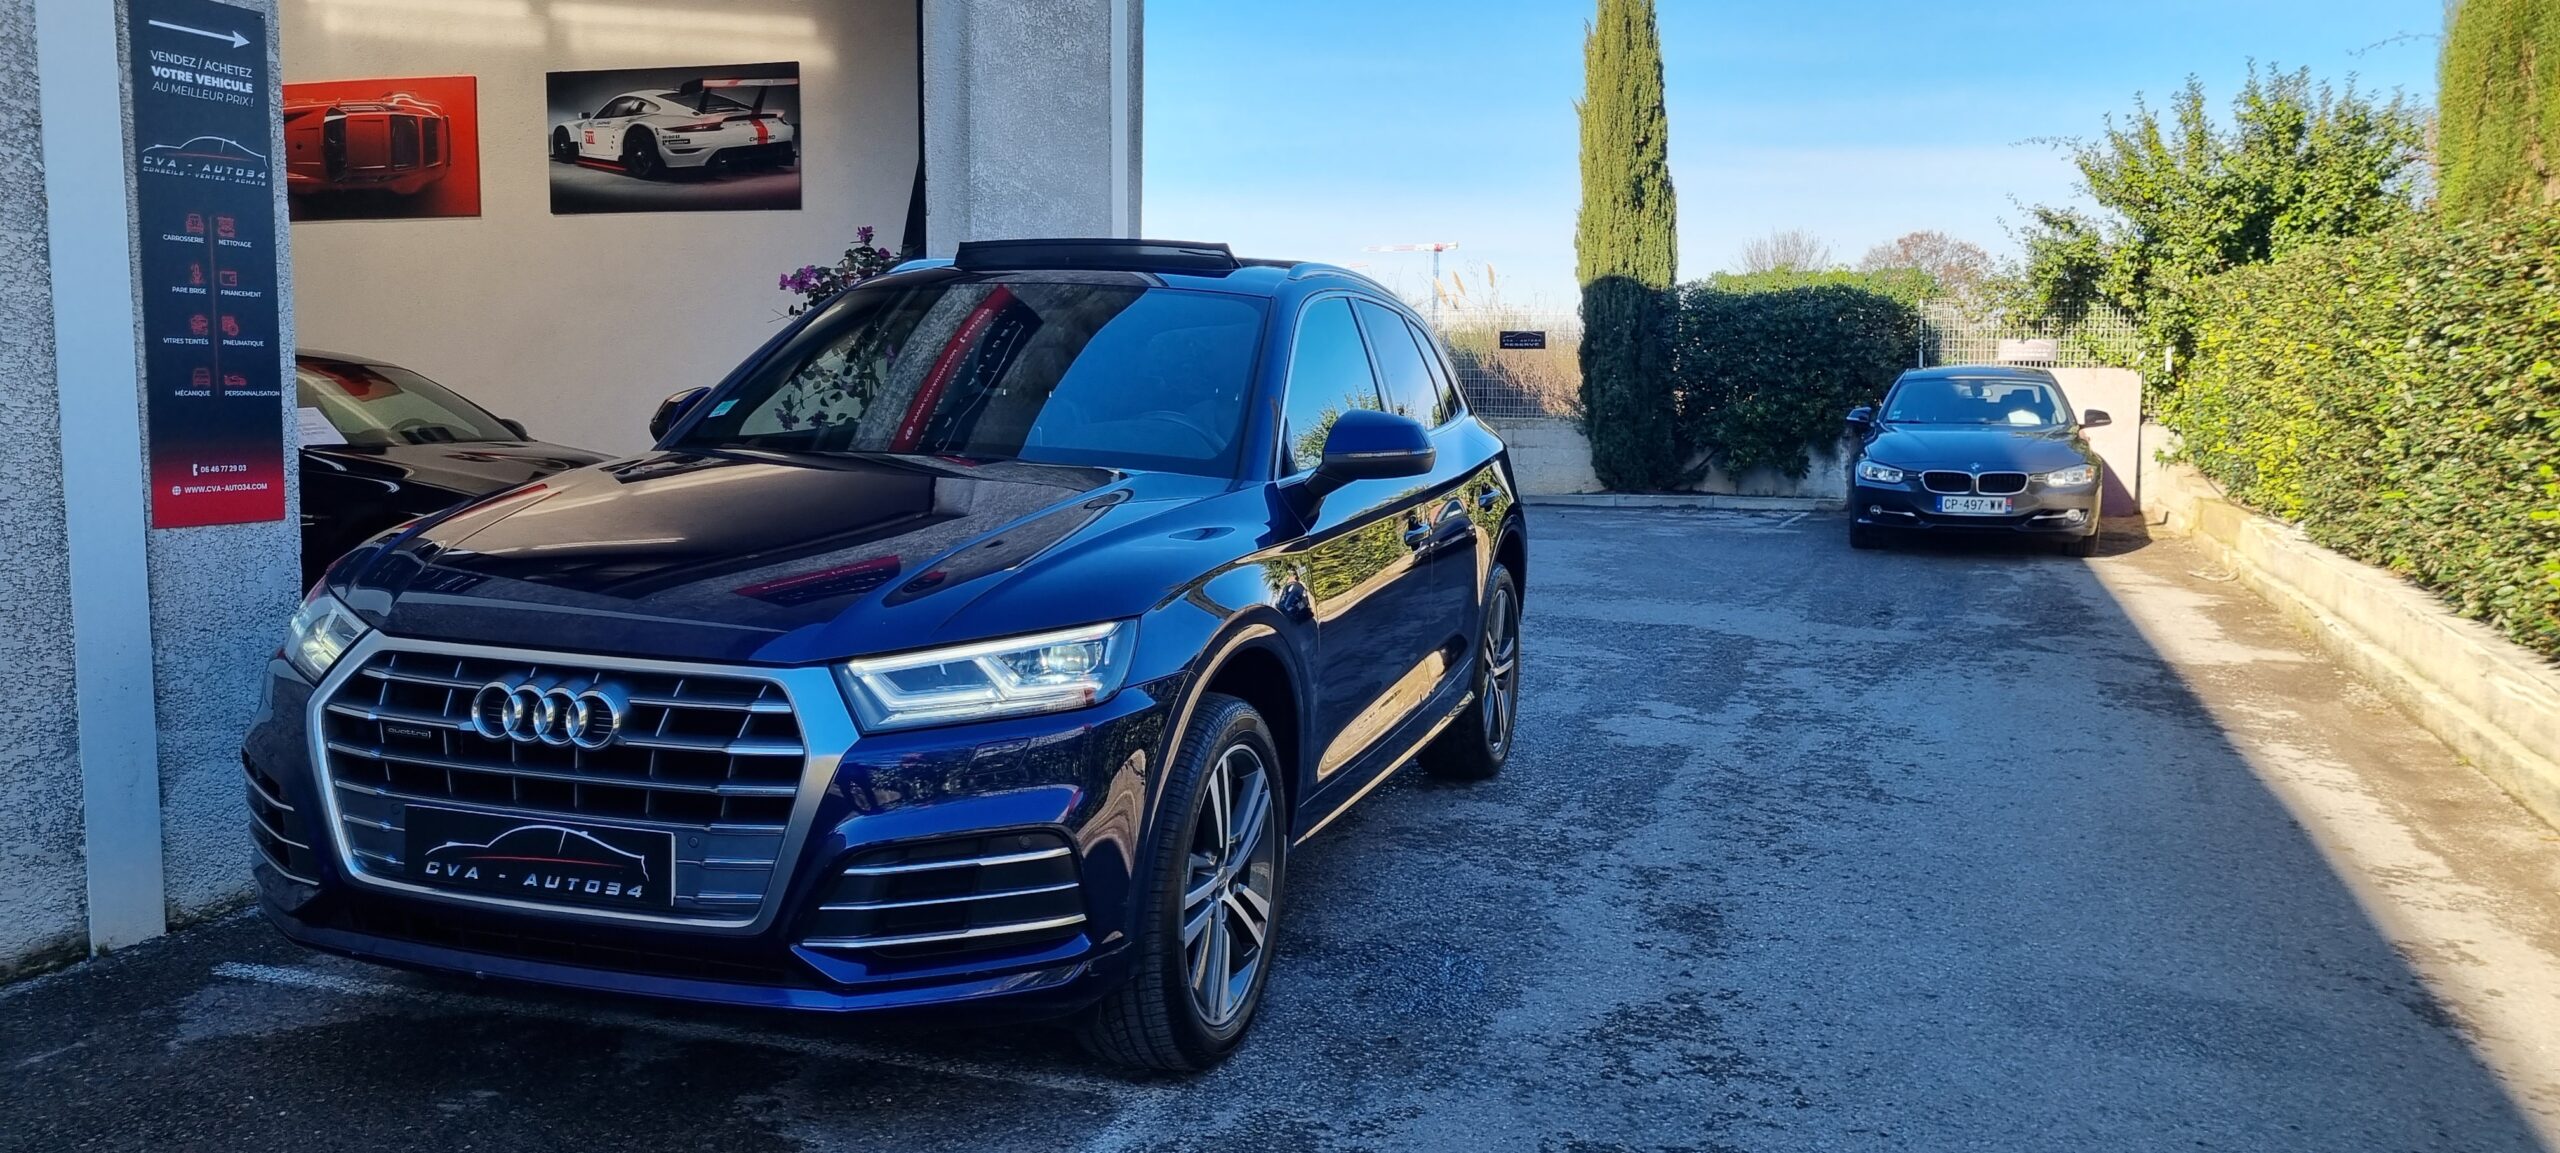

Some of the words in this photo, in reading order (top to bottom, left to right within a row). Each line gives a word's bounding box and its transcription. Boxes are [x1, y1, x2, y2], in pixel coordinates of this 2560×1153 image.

[150, 49, 196, 68] VENDEZ
[197, 58, 203, 70] /
[204, 60, 253, 78] ACHETEZ
[151, 65, 193, 83] VOTRE
[195, 73, 254, 94] VEHICULE
[152, 81, 169, 92] AU
[171, 83, 224, 102] MEILLEUR
[225, 93, 249, 106] PRIX
[143, 155, 177, 168] CVA
[202, 163, 266, 179] AUTO34
[162, 234, 205, 244] CARROSSERIE
[218, 239, 252, 248] NETTOYAGE
[172, 286, 189, 294] PARE
[189, 287, 207, 295] BRISE
[220, 289, 262, 298] FINANCEMENT
[163, 337, 184, 345] VITRES
[222, 339, 265, 347] PNEUMATIQUE
[174, 388, 211, 397] MÉCANIQUE
[184, 482, 268, 494] WWW.CVA-AUTO34.COM
[425, 861, 479, 880] CVA
[523, 873, 643, 898] AUTO34
